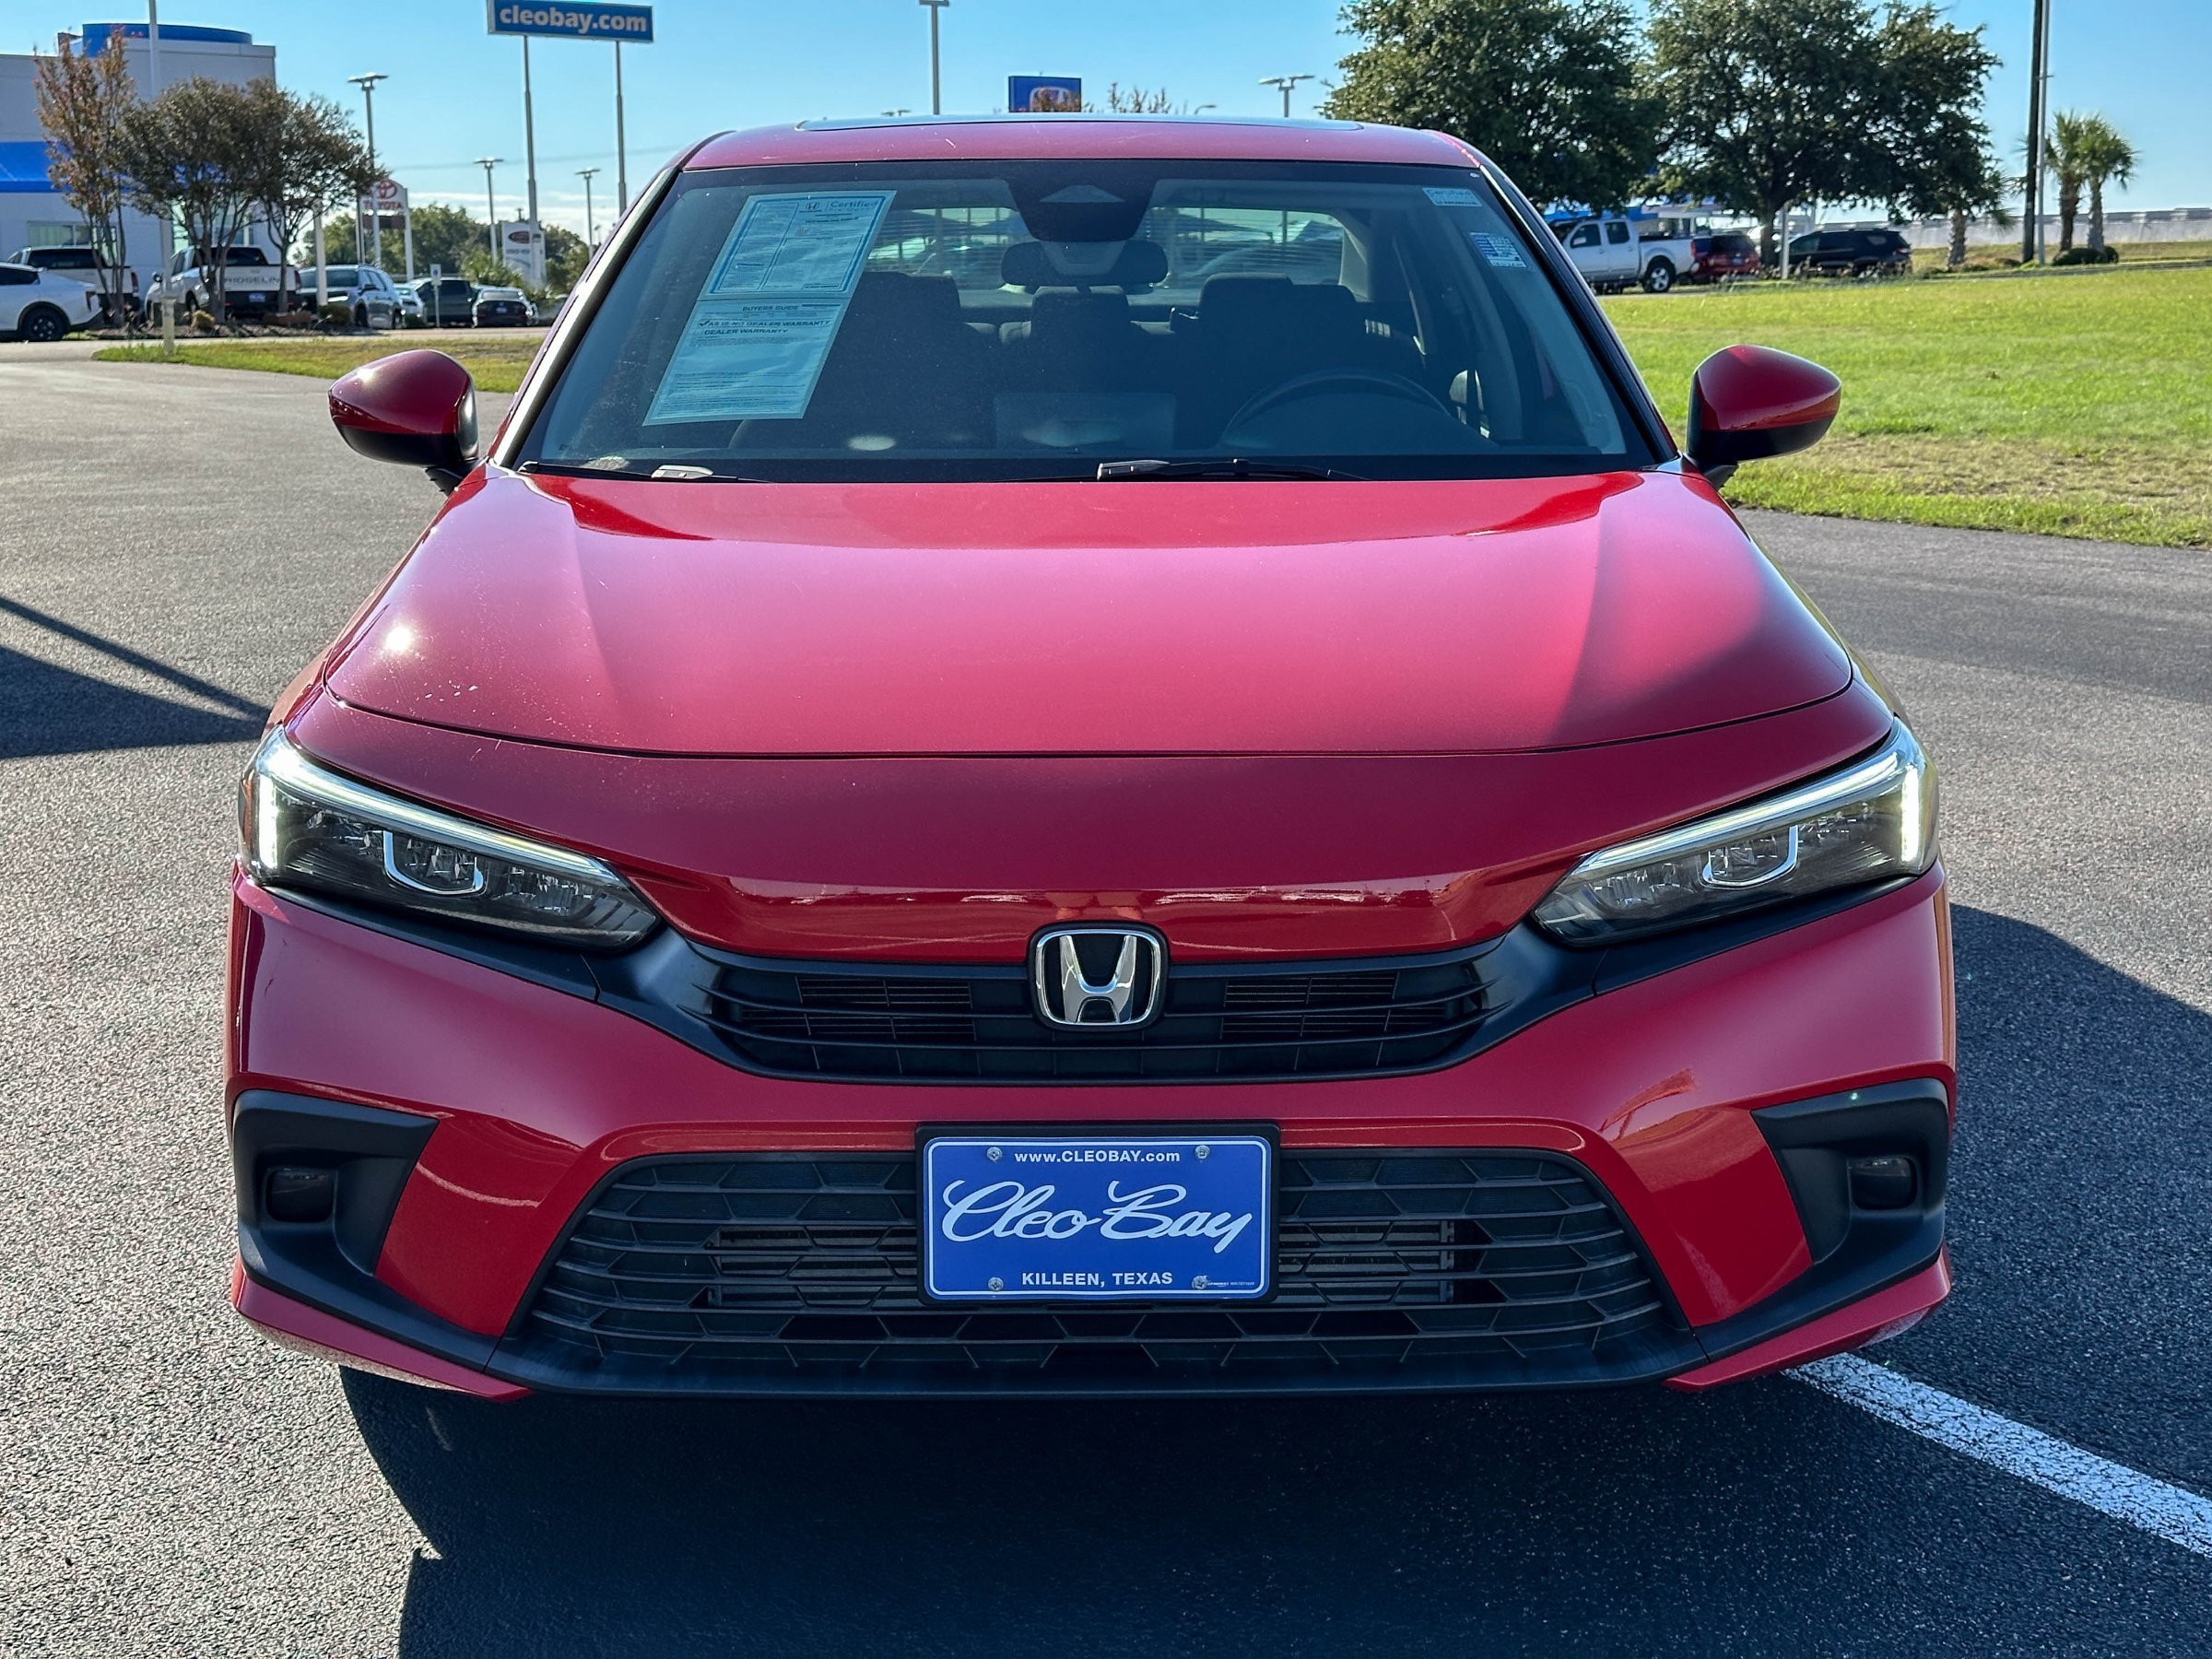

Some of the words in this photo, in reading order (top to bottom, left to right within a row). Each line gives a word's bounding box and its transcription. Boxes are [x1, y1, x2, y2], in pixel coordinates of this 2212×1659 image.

[500, 5, 647, 34] cleobay.com
[363, 200, 404, 209] TYOTA
[1014, 1150, 1181, 1163] www.CLEOBAY.com
[942, 1180, 1101, 1241] Cleo
[1100, 1180, 1253, 1253] Bay
[1022, 1273, 1105, 1288] KILLEEN,
[1112, 1272, 1173, 1287] TEXAS
